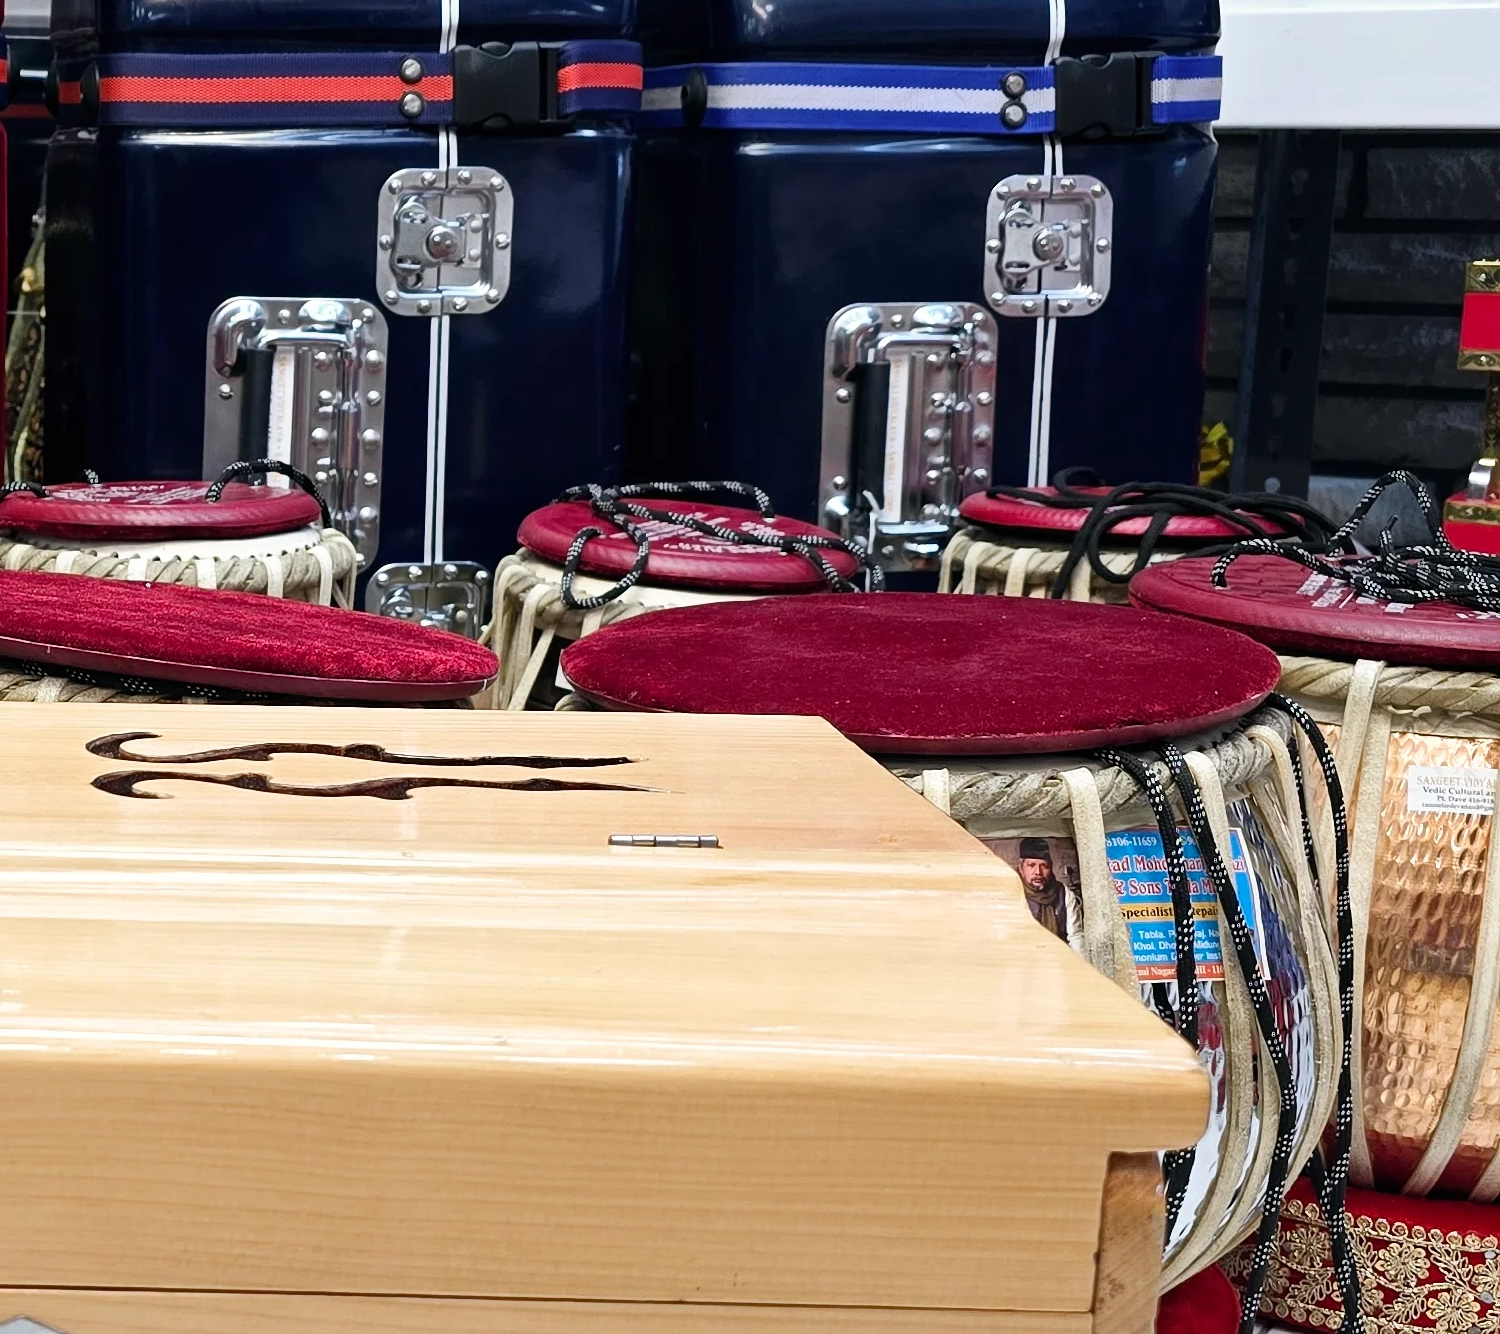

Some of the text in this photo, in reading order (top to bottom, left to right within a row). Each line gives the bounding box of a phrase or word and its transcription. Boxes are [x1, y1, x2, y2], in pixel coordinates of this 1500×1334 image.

[1416, 775, 1462, 787] SANGEET
[1423, 786, 1446, 794] Vedic
[1448, 787, 1483, 796] Cultural
[1129, 878, 1162, 895] Sons
